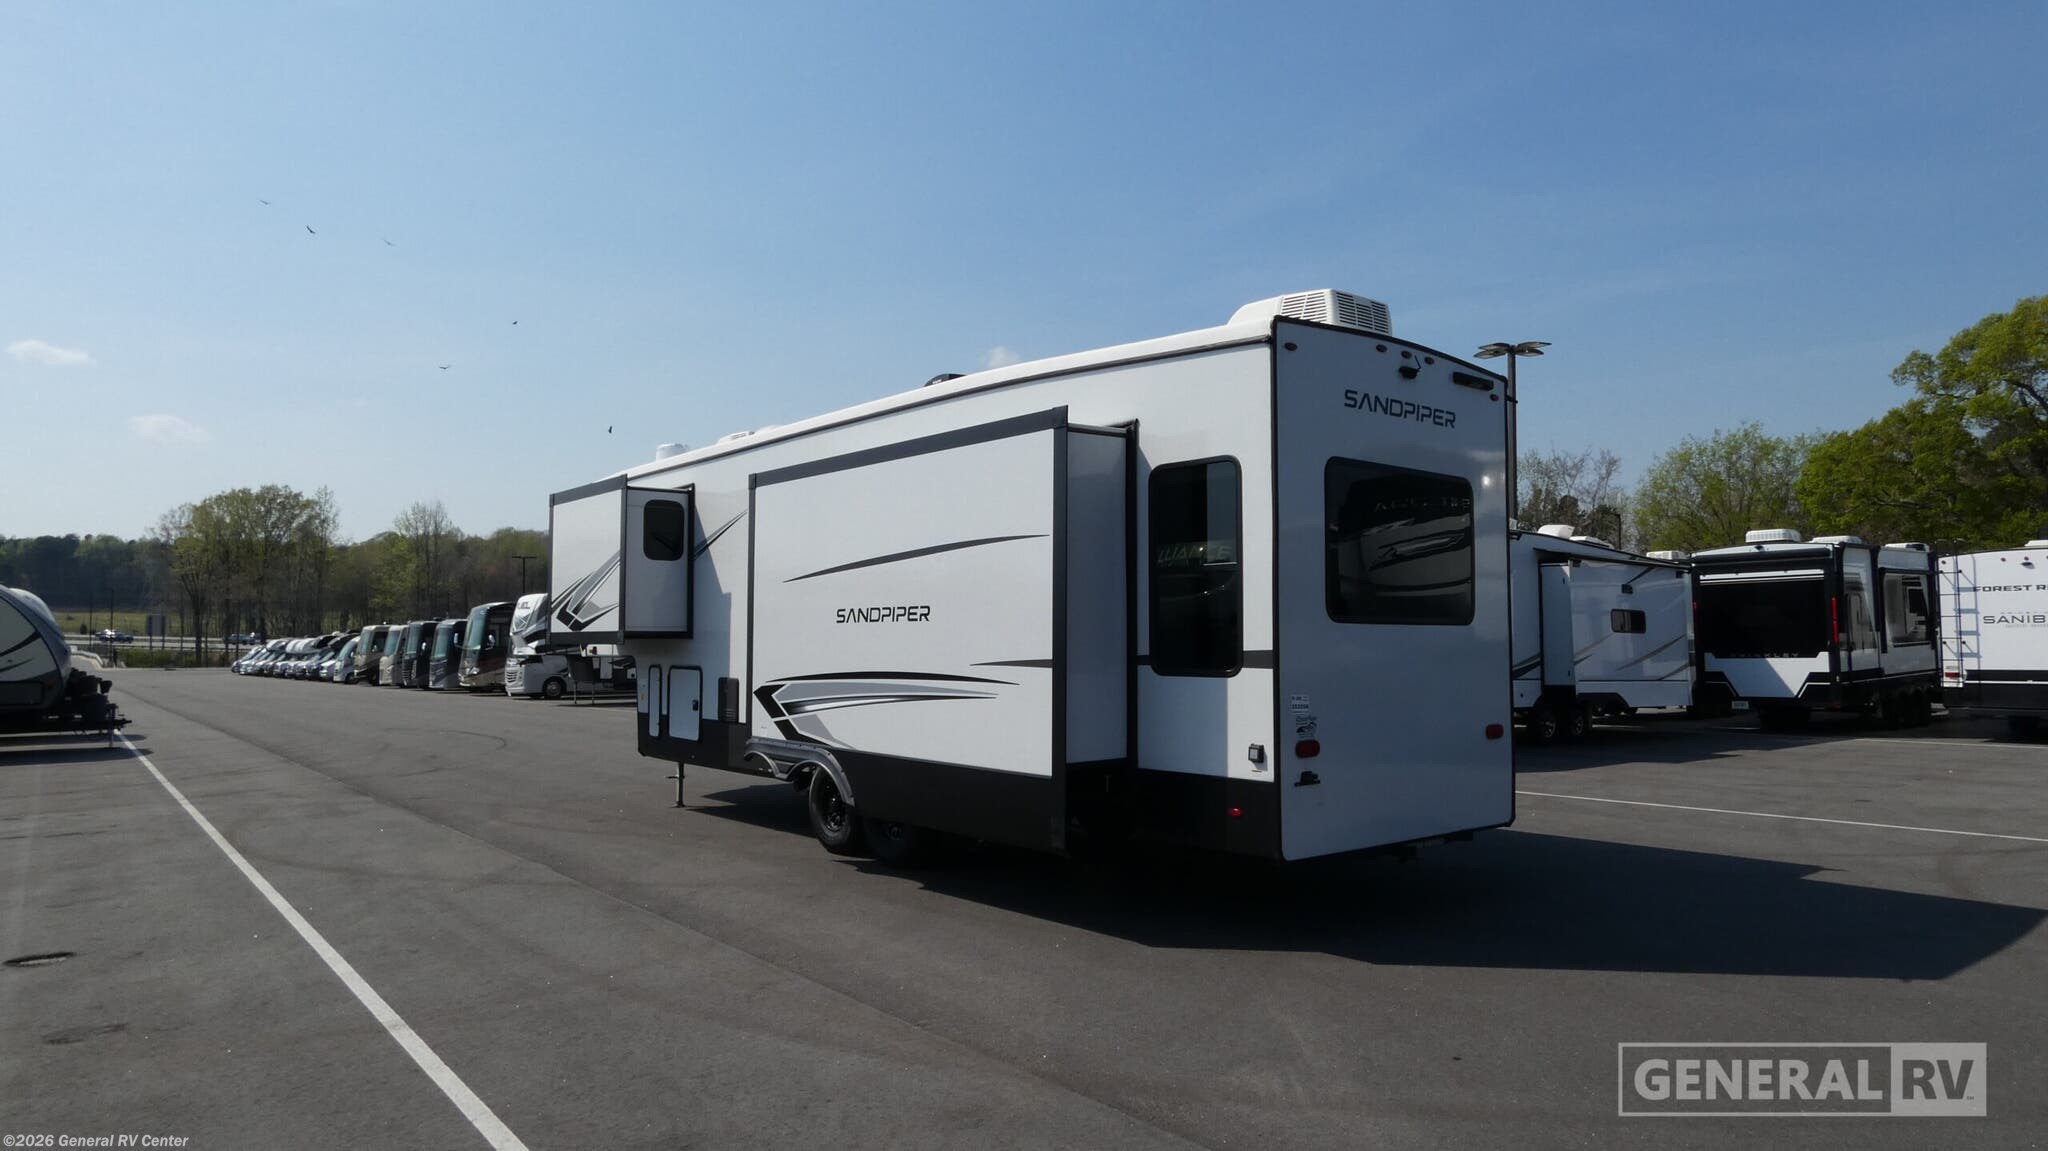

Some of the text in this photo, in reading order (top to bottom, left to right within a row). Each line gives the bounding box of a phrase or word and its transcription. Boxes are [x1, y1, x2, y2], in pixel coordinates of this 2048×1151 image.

[1344, 389, 1456, 429] SANDPIPER
[1973, 584, 2032, 592] FOREST
[836, 605, 930, 624] SANDPIPER
[1983, 614, 2046, 624] SANIB
